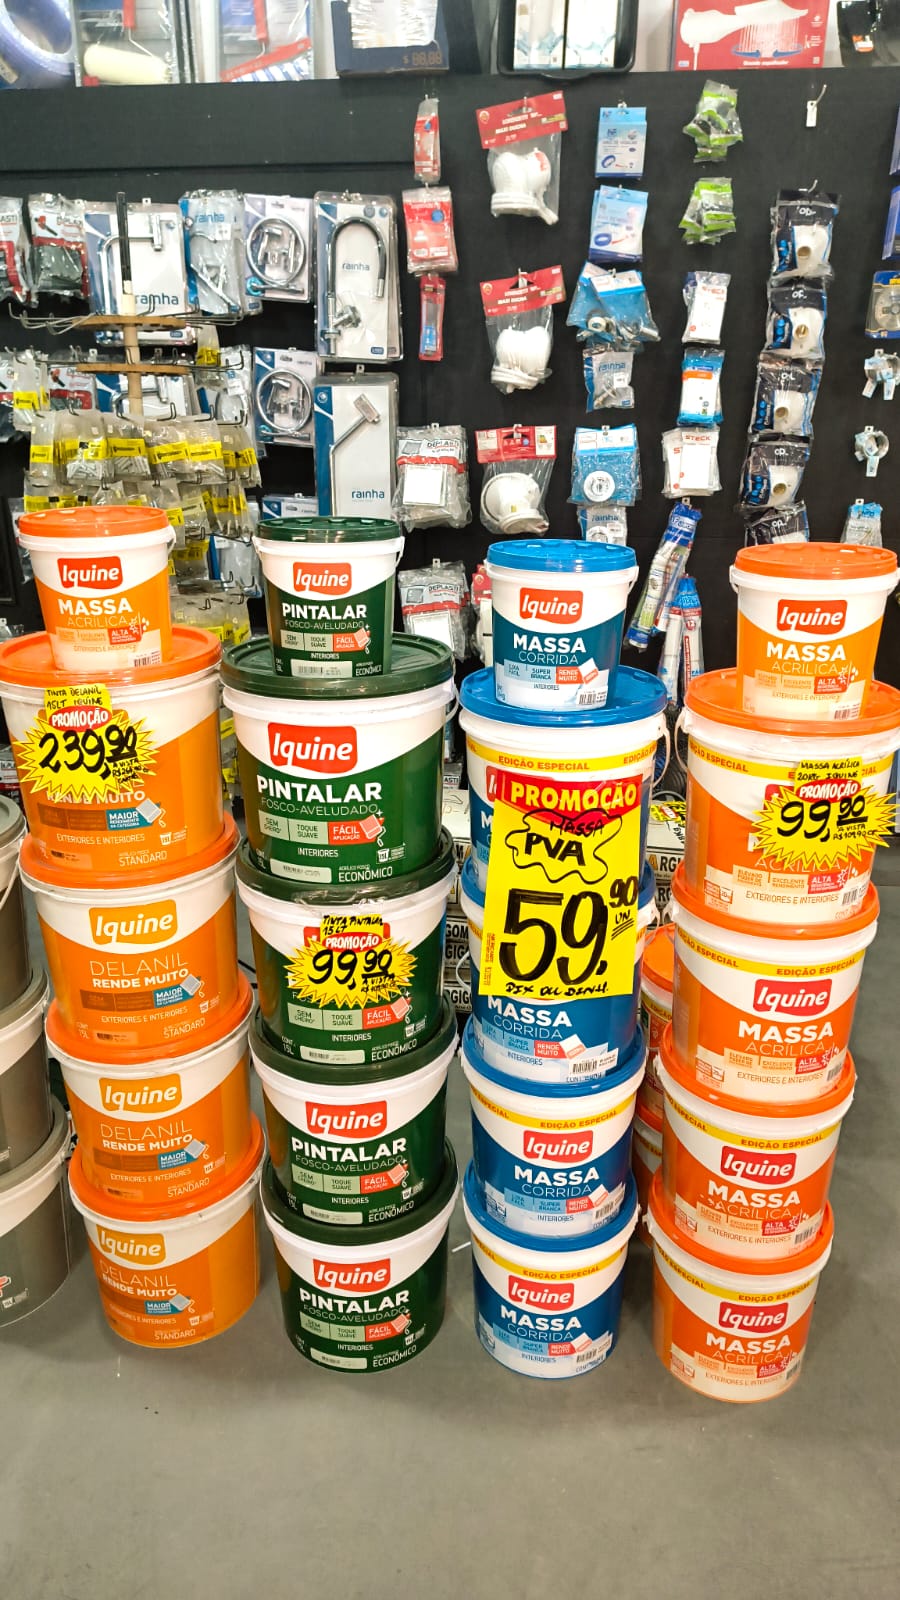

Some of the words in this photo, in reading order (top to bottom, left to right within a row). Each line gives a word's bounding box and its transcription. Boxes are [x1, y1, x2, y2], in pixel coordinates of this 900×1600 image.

[342, 262, 370, 271] rainha
[135, 293, 179, 305] rainha
[351, 489, 385, 499] rainha
[63, 564, 120, 587] Iquine
[296, 569, 349, 591] Iquine
[58, 598, 133, 616] MASSA
[282, 603, 367, 620] PINTALAR
[522, 595, 580, 618] Iquine
[285, 620, 364, 630] FOSCO-AVELUDADO
[780, 606, 843, 630] Iquine
[513, 632, 586, 653] MASSA
[766, 641, 846, 662] MASSA
[518, 651, 578, 665] CORRIDA
[52, 708, 108, 728] PROMOÇÃO
[273, 733, 352, 766] Iquine
[498, 756, 534, 768] EDIÇÃO
[537, 761, 590, 771] ESPECIAL
[706, 754, 748, 773] ESPECIAL
[256, 775, 382, 804] PINTALAR
[511, 780, 637, 813] PROMOÇÃO
[800, 780, 858, 800] PROMOÇÃO
[109, 811, 139, 820] MAIOR
[261, 797, 379, 816] FOSCO-AVELUDADO
[265, 818, 279, 826] SEM
[296, 824, 318, 832] TOQUE
[333, 825, 360, 835] FÁCIL
[550, 816, 605, 838] MASSA
[56, 833, 95, 844] EXTERIORES
[96, 836, 101, 844] E
[102, 833, 145, 844] INTERIORES
[119, 850, 167, 867] STANDARD
[298, 848, 339, 858] INTERIORES
[525, 832, 586, 866] PVA
[338, 866, 393, 882] ECONÔMICO
[609, 876, 638, 909] 90
[746, 891, 791, 904] EXTERIORES
[792, 896, 798, 904] E
[800, 894, 838, 904] INTERIORES
[324, 915, 347, 925] TINTA
[615, 910, 631, 924] UN
[95, 913, 173, 943] Iquine
[323, 926, 334, 936] 15
[325, 934, 379, 951] PROMOÇÃO
[89, 952, 188, 977] DELANIL
[362, 949, 392, 973] 90
[696, 945, 739, 968] ESPECIAL
[776, 968, 816, 977] EDIÇÃO
[819, 957, 855, 975] ESPECIAL
[92, 977, 141, 989] RENDE
[145, 968, 189, 986] MUITO
[156, 987, 182, 998] MAIOR
[757, 986, 828, 1012] Iquine
[101, 1014, 141, 1023] EXTERIORES
[149, 1006, 188, 1021] INTERIORES
[297, 1009, 312, 1018] SEM
[367, 1008, 390, 1020] FÁCIL
[488, 996, 572, 1027] MASSA
[163, 1018, 206, 1039] STANDARD
[493, 1014, 563, 1039] CORRIDA
[738, 1020, 833, 1044] MASSA
[332, 1033, 372, 1042] INTERIORES
[371, 1038, 418, 1062] ECONÔMICO
[744, 1042, 825, 1057] ACRÍLICA
[799, 1058, 816, 1066] ALTA
[737, 1072, 781, 1084] EXTERIORES
[105, 1086, 177, 1111] Iquine
[310, 1108, 383, 1135] Iquine
[540, 1122, 576, 1130] EDIÇÃO
[579, 1110, 617, 1126] ESPECIAL
[100, 1120, 192, 1141] DELANIL
[102, 1139, 146, 1152] RENDE
[150, 1134, 193, 1150] MUITO
[291, 1136, 407, 1163] PINTALAR
[526, 1137, 590, 1160] Iquine
[741, 1139, 779, 1149] EDIÇÃO
[782, 1135, 823, 1148] ESPECIAL
[160, 1151, 186, 1162] MAIOR
[295, 1154, 403, 1172] FOSCO-AVELUDADO
[724, 1154, 792, 1178] Iquine
[364, 1176, 387, 1185] FÁCIL
[514, 1165, 600, 1186] MASSA
[168, 1178, 210, 1198] STANDARD
[521, 1184, 592, 1198] CORRIDA
[708, 1180, 800, 1208] MASSA
[368, 1201, 414, 1222] ECONÔMICO
[101, 1231, 161, 1256] Iquine
[100, 1259, 177, 1287] DELANIL
[318, 1264, 387, 1288] Iquine
[523, 1270, 557, 1279] EDIÇÃO
[560, 1266, 600, 1279] ESPECIAL
[102, 1273, 134, 1294] RENDE
[137, 1288, 177, 1297] MUITO
[511, 1282, 571, 1304] Iquine
[299, 1288, 409, 1313] PINTALAR
[303, 1305, 407, 1322] FOSCO-AVELUDADO
[501, 1305, 582, 1332] MASSA
[722, 1308, 784, 1329] Iquine
[154, 1329, 196, 1340] STANDARD
[369, 1326, 391, 1334] FÁCIL
[508, 1324, 573, 1341] CORRIDA
[706, 1332, 791, 1355] MASSA
[373, 1345, 416, 1368] ECONÔMICO
